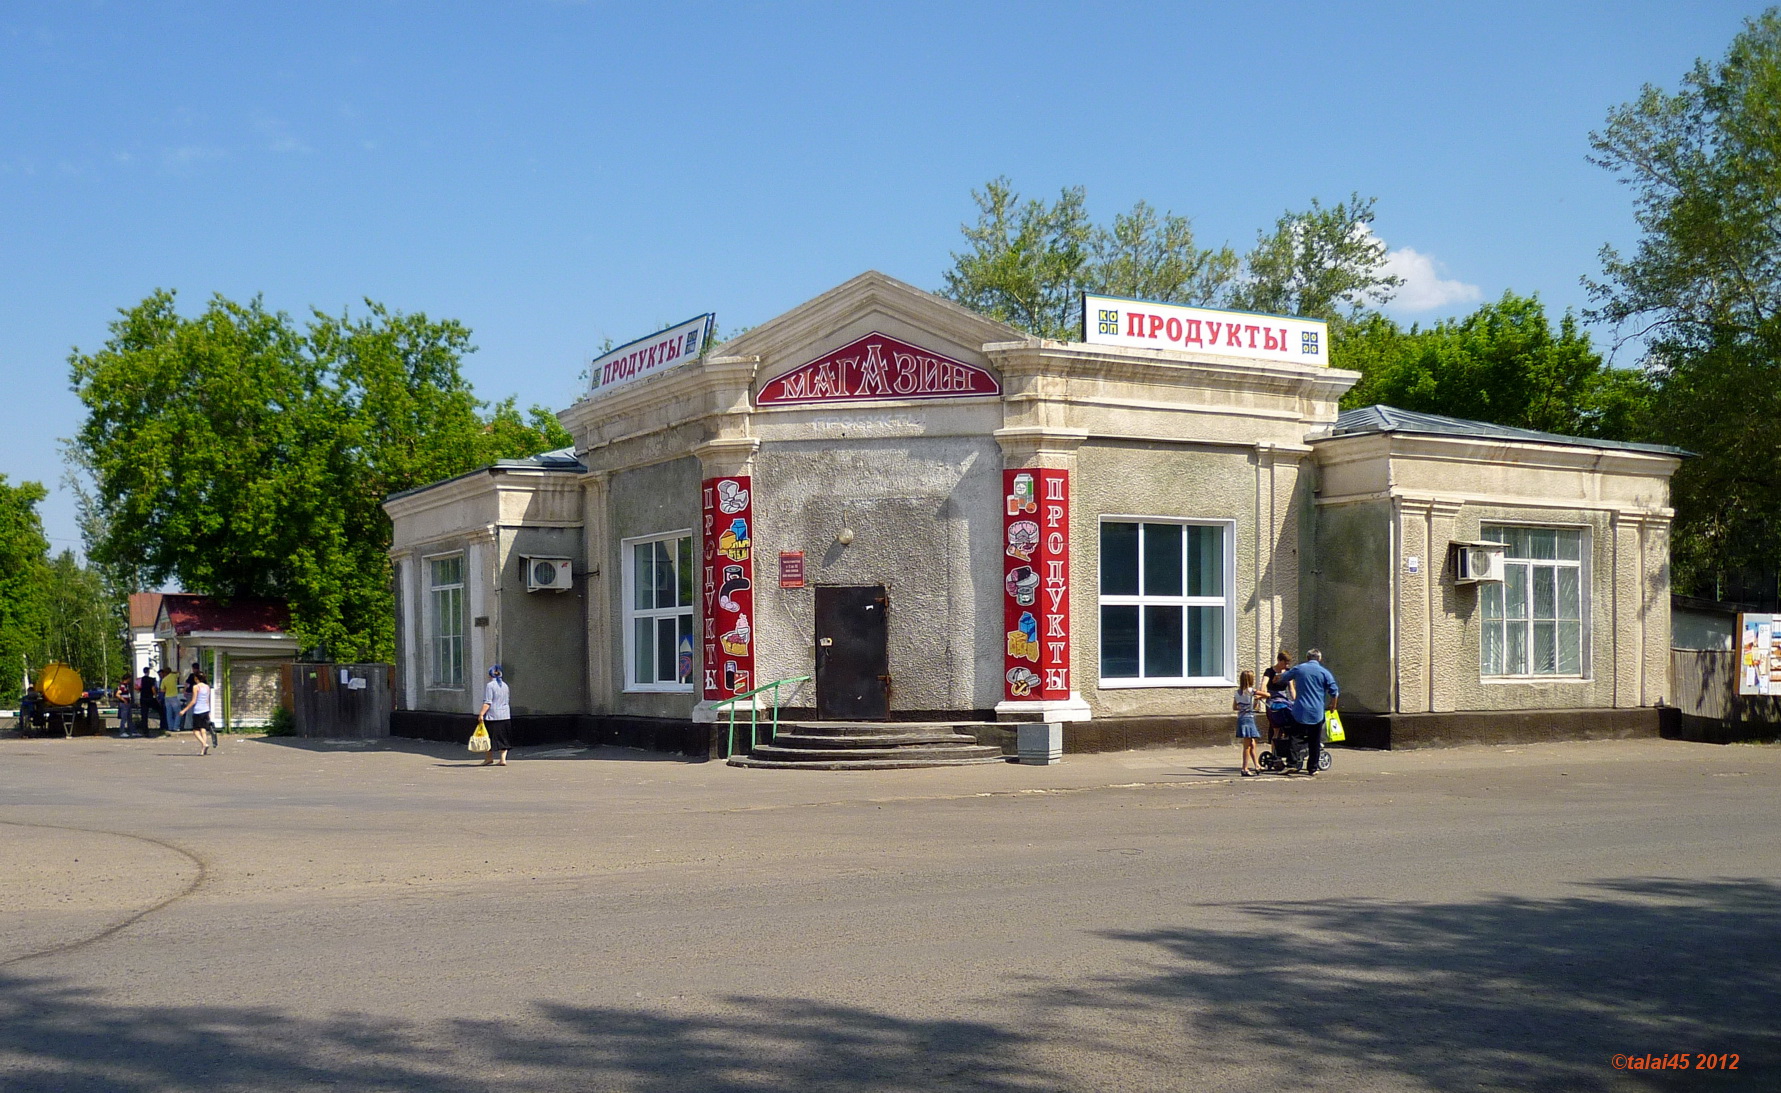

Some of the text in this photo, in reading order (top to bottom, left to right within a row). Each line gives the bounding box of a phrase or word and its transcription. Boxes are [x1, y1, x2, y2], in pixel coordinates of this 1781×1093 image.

[601, 335, 684, 381] ПРОДУКТЫ
[1126, 312, 1288, 352] ПРОДУКТЫ
[775, 344, 977, 399] МАГАЗИН
[704, 487, 718, 690] ПРОДУКТЫ
[1045, 477, 1067, 691] ПРОДУКТЫ
